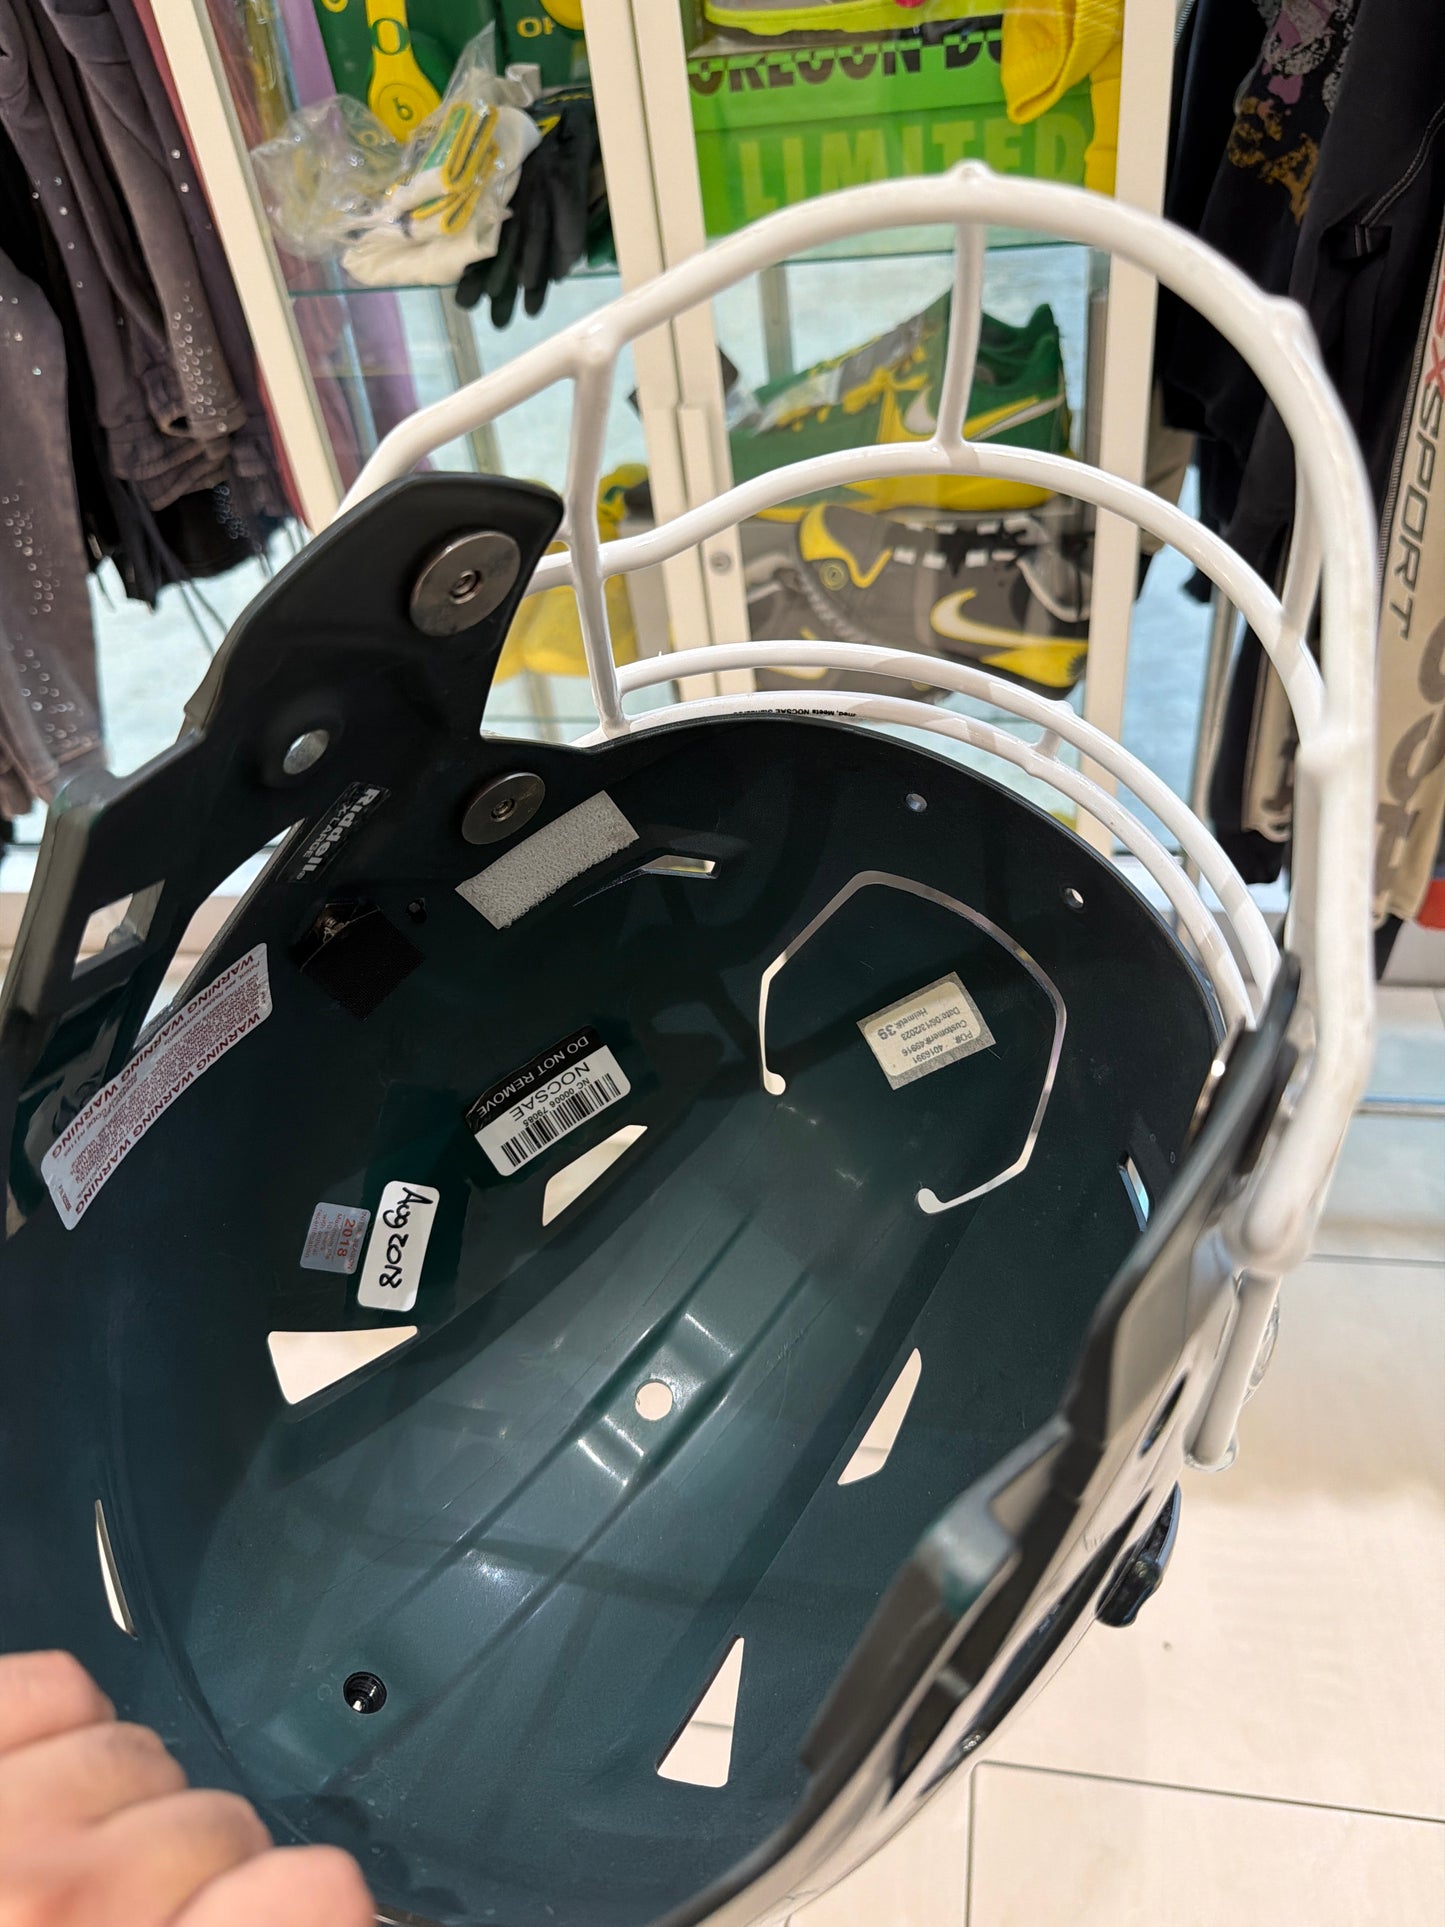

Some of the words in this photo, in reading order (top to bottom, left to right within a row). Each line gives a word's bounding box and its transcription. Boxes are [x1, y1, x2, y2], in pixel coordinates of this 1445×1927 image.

[688, 37, 922, 96] OREGON
[738, 112, 1087, 219] LIMITED
[302, 789, 380, 872] Riddell
[303, 804, 350, 859] X-LARGE
[186, 954, 254, 1015] WARNING
[119, 1013, 184, 1083] WARNING
[196, 1013, 261, 1072] WARNING
[566, 1036, 589, 1056] DO
[877, 1024, 897, 1042] 39
[537, 1051, 566, 1077] NOT
[576, 1078, 590, 1090] NC
[132, 1070, 194, 1138] WARNING
[476, 1072, 535, 1119] REMOVE
[509, 1062, 590, 1122] NOCSAE
[522, 1107, 548, 1127] 79085
[549, 1088, 575, 1108] 00006
[49, 1082, 118, 1160] WARNING
[73, 1139, 131, 1215] WARNING
[383, 1187, 433, 1228] Aug
[337, 1218, 356, 1258] 2018
[380, 1234, 409, 1289] 2018
